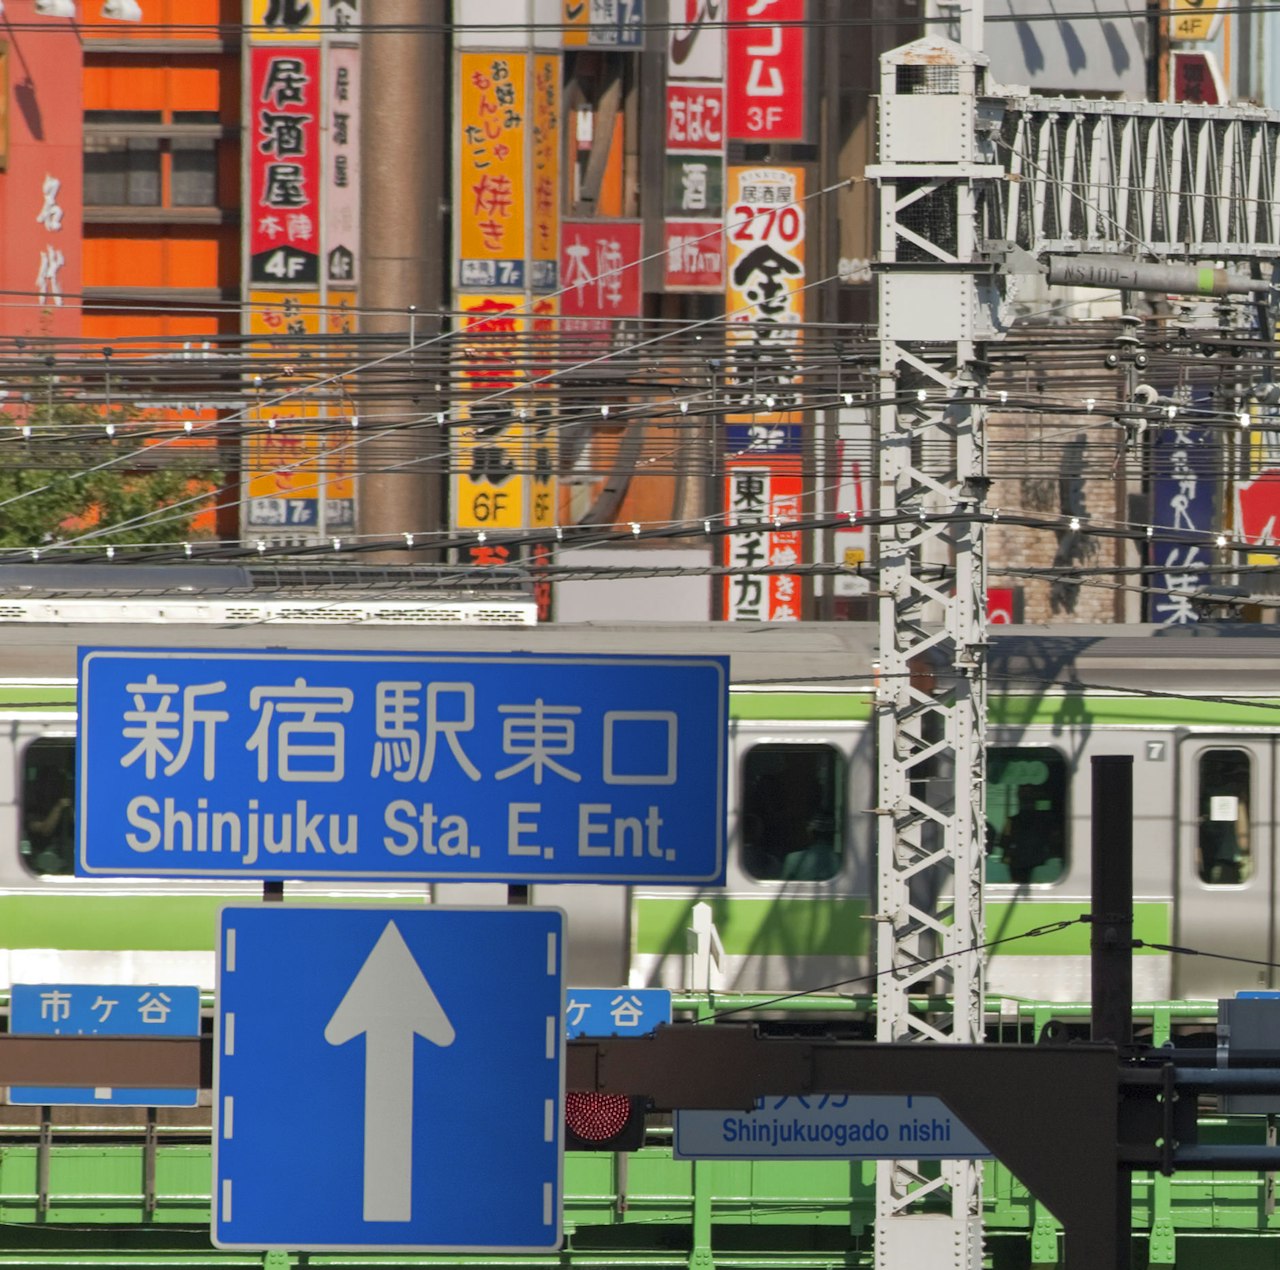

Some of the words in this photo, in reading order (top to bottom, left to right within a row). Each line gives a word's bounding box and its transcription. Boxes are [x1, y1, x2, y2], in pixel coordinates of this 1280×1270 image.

[1177, 18, 1203, 33] 4F
[491, 60, 522, 129] お好み
[259, 56, 315, 209] 居酒屋
[472, 71, 510, 162] もんじゃ
[669, 95, 721, 143] たばこ
[747, 108, 783, 132] 3F
[464, 125, 492, 170] たこ
[682, 163, 708, 210] 酒
[741, 185, 792, 204] 居酒屋
[472, 174, 513, 252] 焼き
[733, 205, 800, 242] 270
[264, 249, 307, 280] 4F
[498, 261, 521, 283] 7F
[289, 500, 312, 523] 7F
[472, 493, 509, 522] 6F
[119, 673, 680, 785] 新宿駅東口
[1148, 744, 1163, 759] 7
[125, 796, 359, 865] Shinjuku
[382, 800, 482, 859] Sta.
[507, 802, 556, 860] E.
[577, 803, 678, 862] Ent.
[721, 1117, 889, 1146] Shinjukuogado
[899, 1117, 951, 1142] nishi
